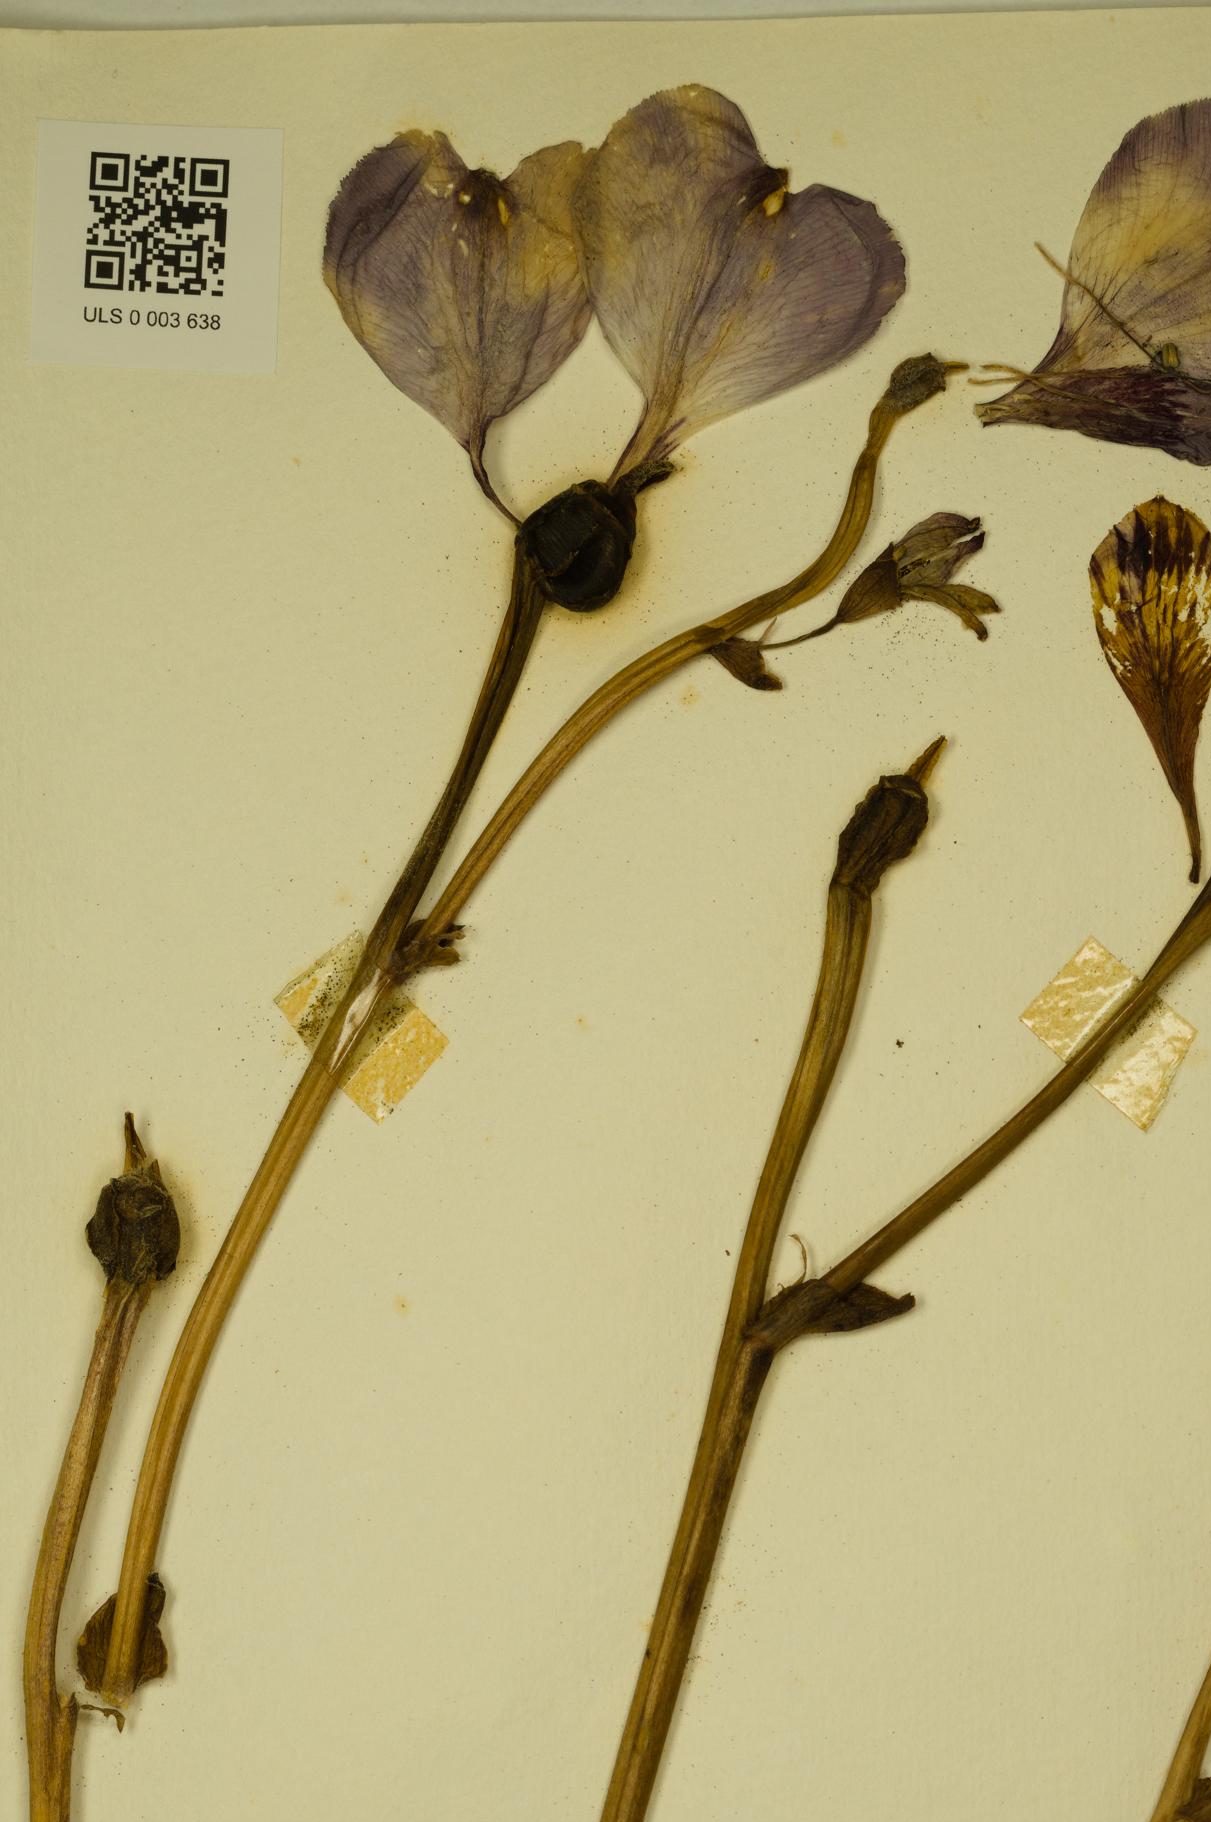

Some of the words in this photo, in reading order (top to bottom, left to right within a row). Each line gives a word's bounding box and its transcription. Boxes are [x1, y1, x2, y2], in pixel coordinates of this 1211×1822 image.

[84, 306, 123, 324] ULS
[130, 310, 140, 325] 0
[147, 311, 181, 327] 003
[187, 313, 221, 330] 638
